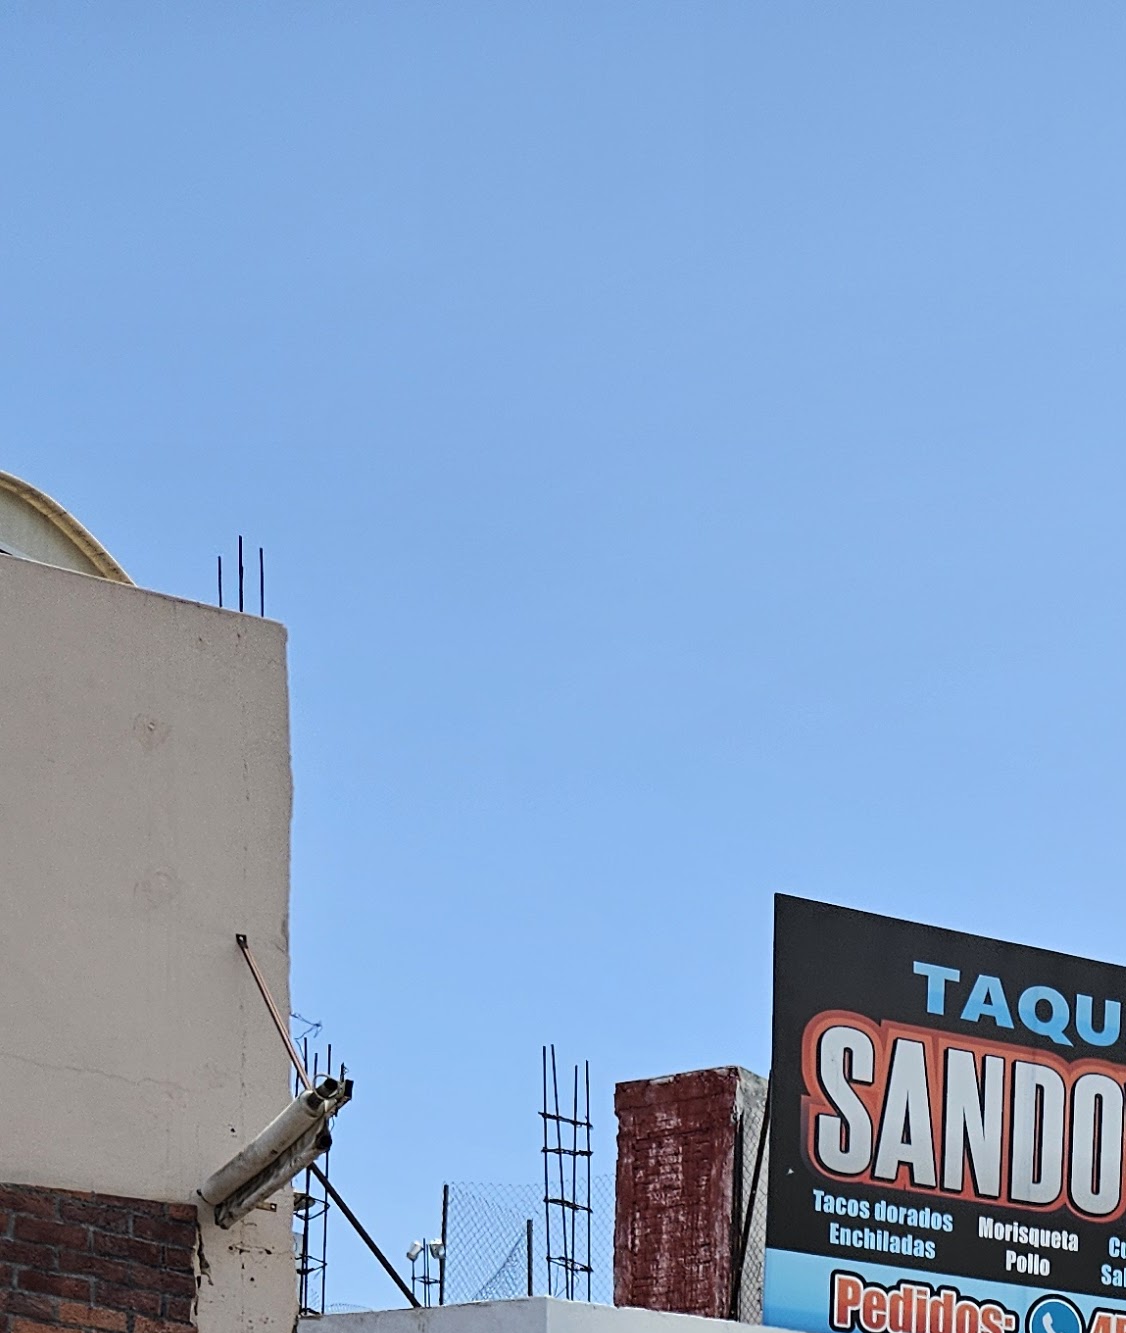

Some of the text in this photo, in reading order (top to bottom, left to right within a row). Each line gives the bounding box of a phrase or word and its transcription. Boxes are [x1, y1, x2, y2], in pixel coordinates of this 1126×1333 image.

[812, 1188, 954, 1232] Tacos dorados
[829, 1222, 936, 1260] Enchiladas
[978, 1216, 1080, 1253] Morisqueta
[1005, 1249, 1051, 1277] Pollo
